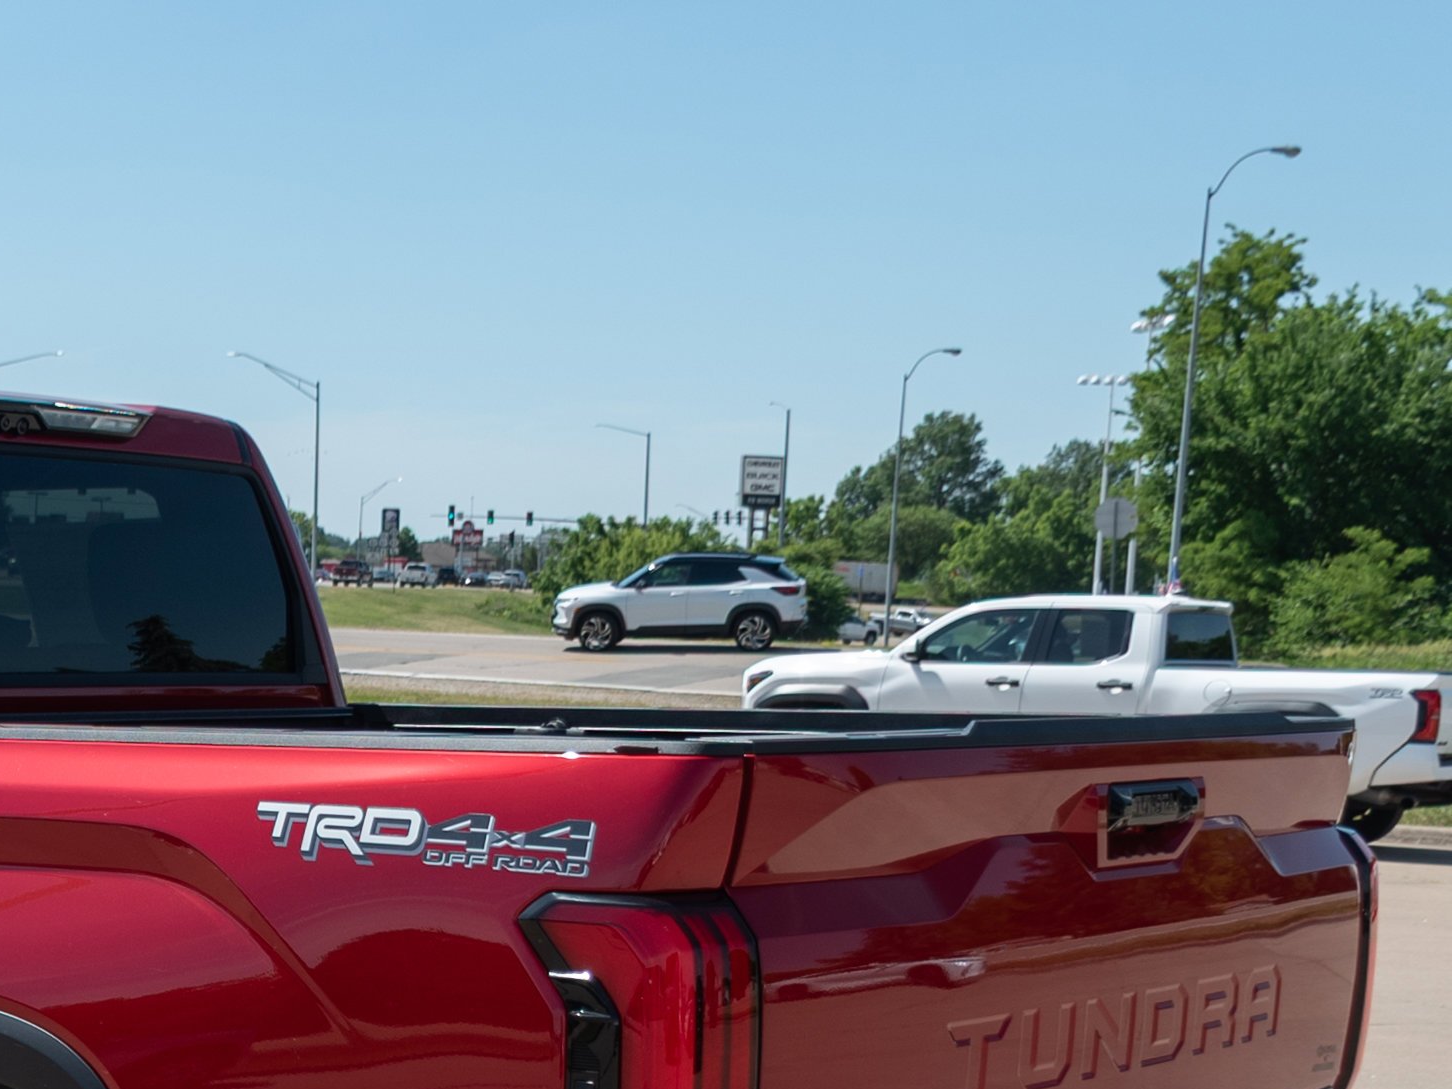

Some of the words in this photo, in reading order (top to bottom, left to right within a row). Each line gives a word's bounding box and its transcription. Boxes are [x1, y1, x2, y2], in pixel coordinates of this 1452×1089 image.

[257, 801, 428, 865] TRD
[426, 813, 596, 863] 4x4
[423, 850, 488, 869] OFF
[492, 854, 590, 877] ROAD
